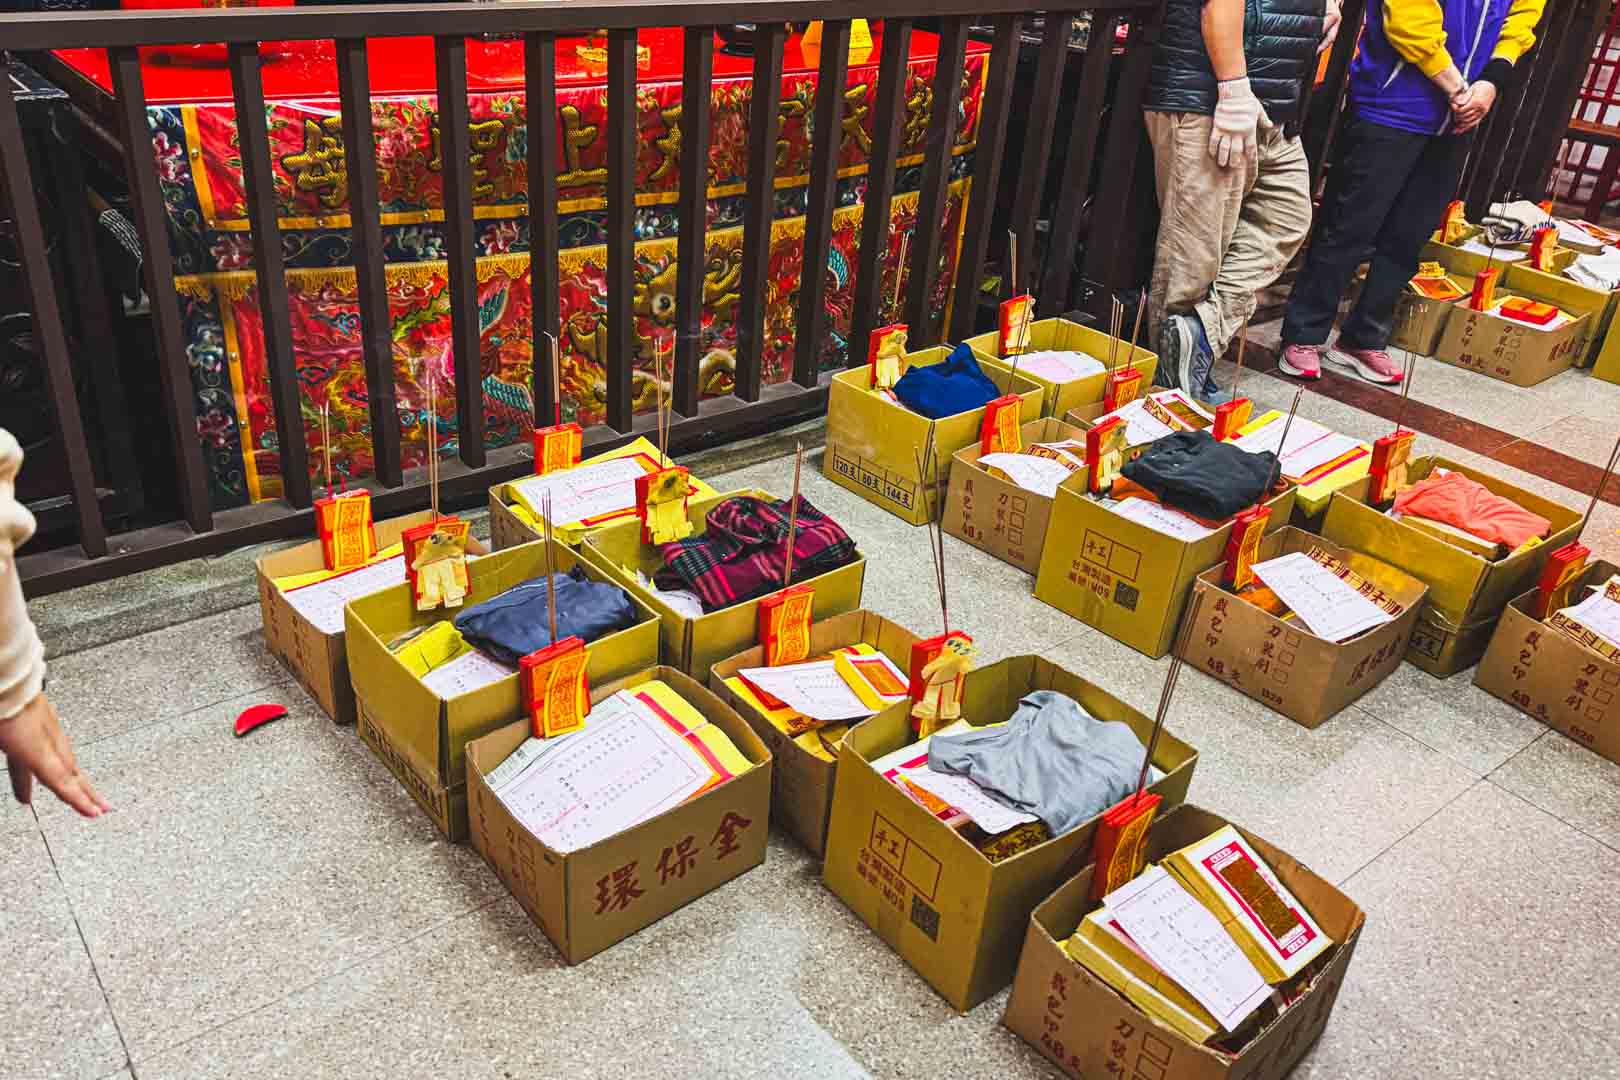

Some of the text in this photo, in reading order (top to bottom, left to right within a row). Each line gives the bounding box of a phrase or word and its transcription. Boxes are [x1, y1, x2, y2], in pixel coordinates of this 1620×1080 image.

[1087, 539, 1108, 560] 手工
[875, 830, 900, 859] 手工
[594, 811, 752, 915] 環保金
